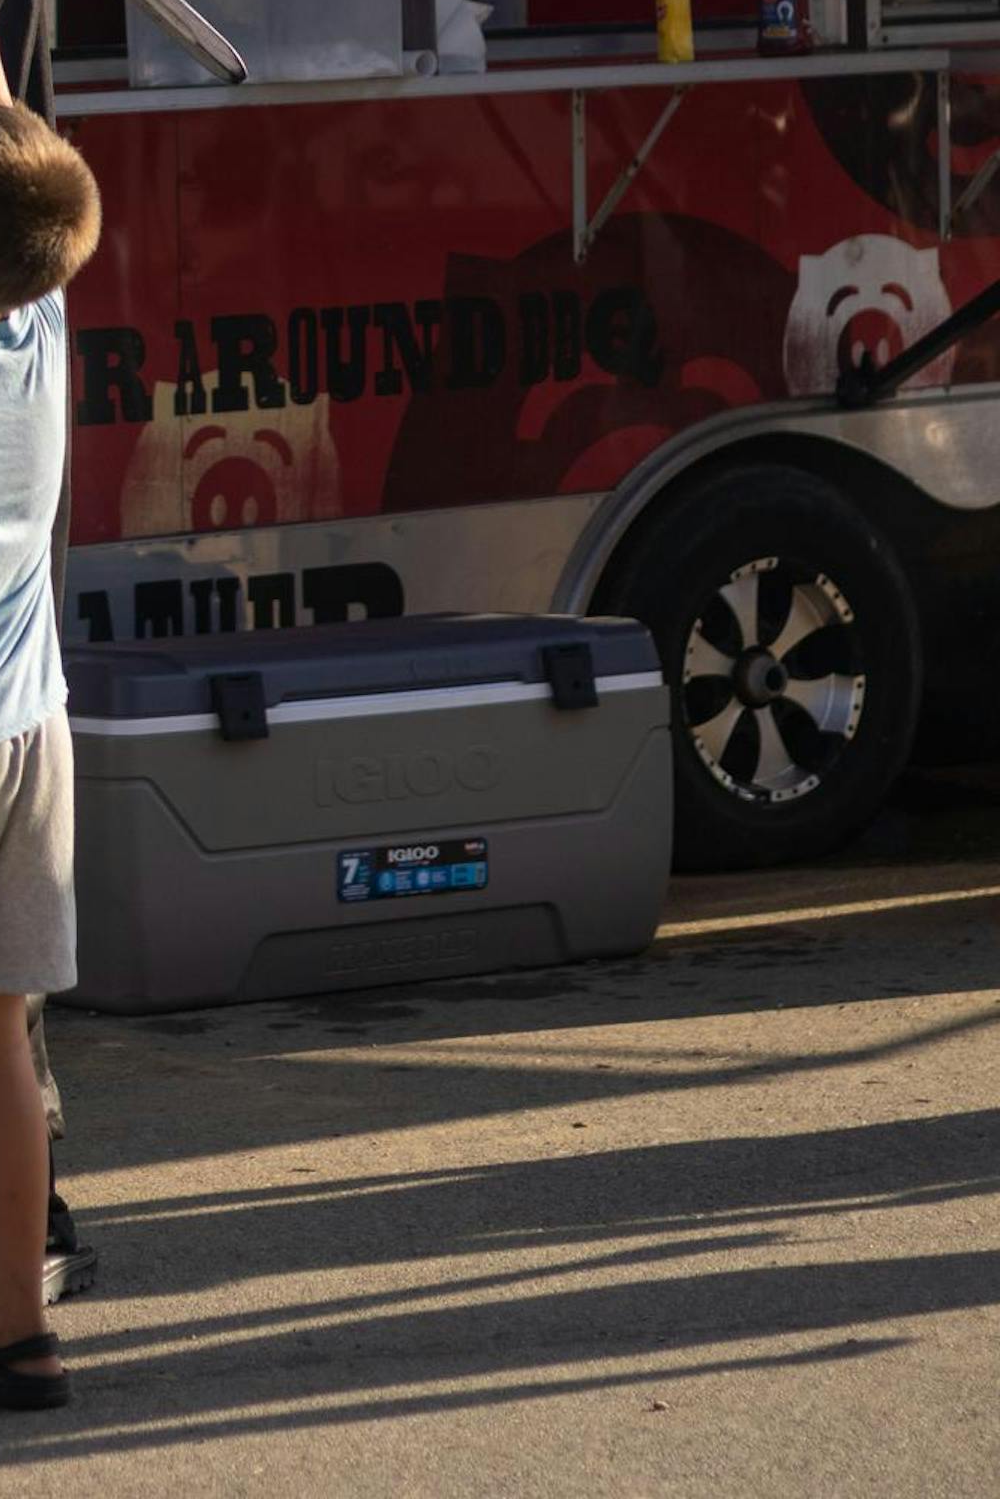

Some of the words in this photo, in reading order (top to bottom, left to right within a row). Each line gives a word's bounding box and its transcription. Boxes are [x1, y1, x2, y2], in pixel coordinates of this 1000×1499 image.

[174, 296, 506, 416] AROUND
[518, 288, 661, 388] BBQ
[387, 845, 440, 863] IGLOO
[342, 857, 360, 885] 7
